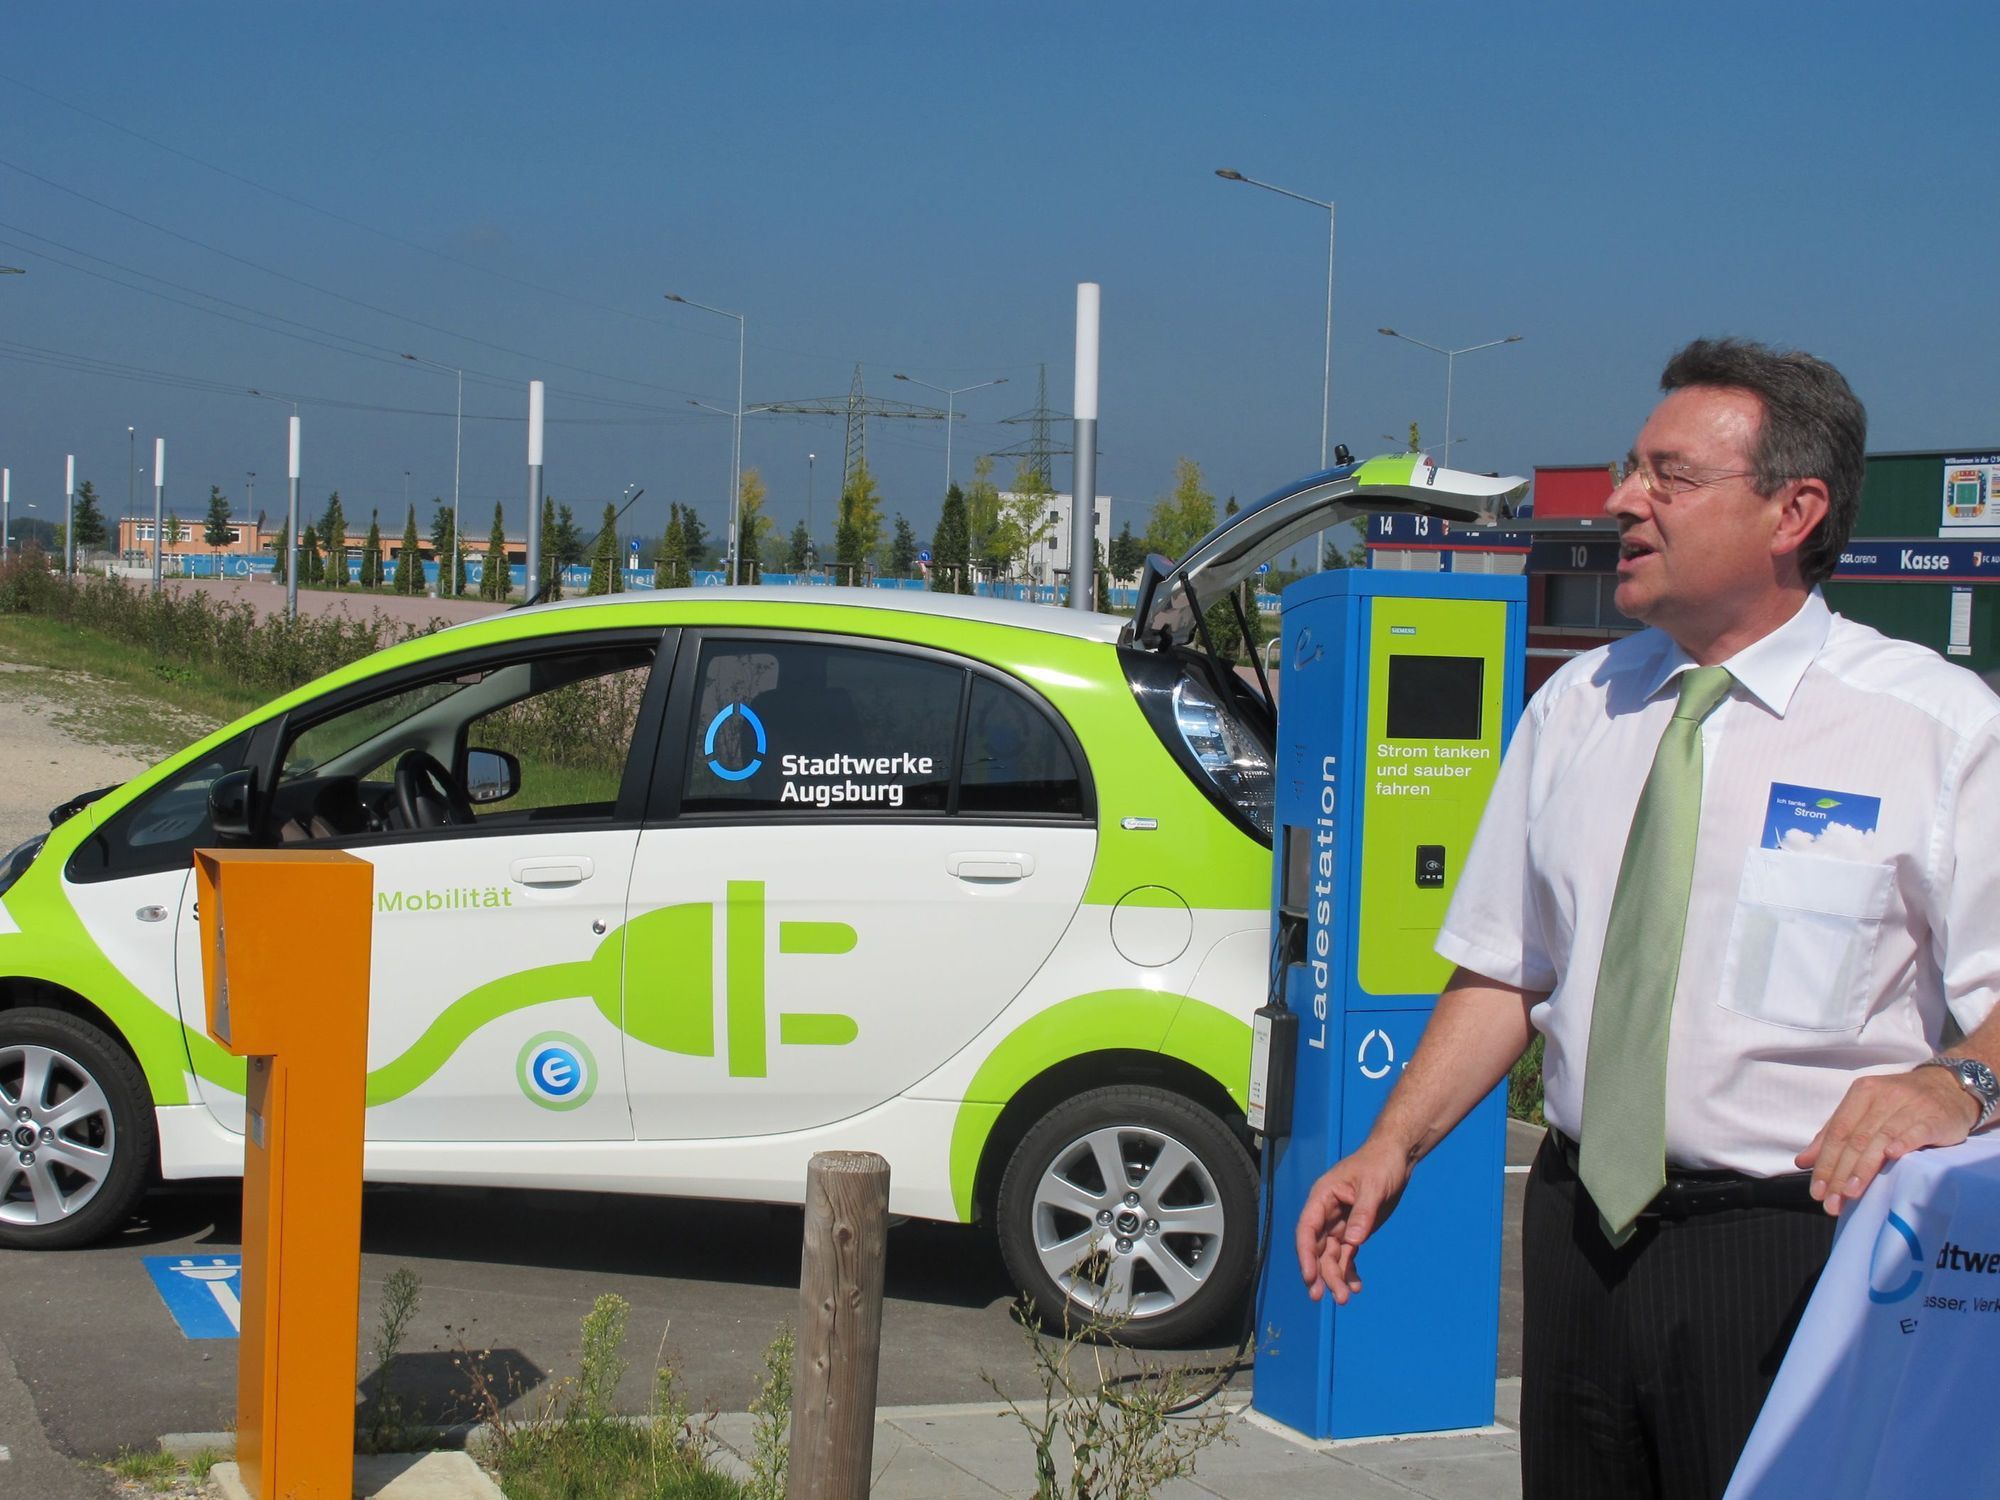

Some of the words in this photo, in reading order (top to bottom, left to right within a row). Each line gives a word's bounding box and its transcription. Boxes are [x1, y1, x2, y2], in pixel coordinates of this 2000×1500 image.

[1379, 516, 1393, 535] 14
[1414, 516, 1429, 536] 13
[1571, 545, 1588, 568] 10
[1901, 549, 1950, 570] Kasse
[1377, 744, 1428, 758] Strom
[1434, 746, 1490, 759] tanken
[782, 752, 934, 776] Stadtwerke
[1376, 764, 1408, 776] und
[1414, 765, 1472, 777] sauber
[780, 780, 904, 808] Augsburg
[1376, 782, 1430, 796] fahren
[1794, 807, 1827, 820] Strom
[1308, 755, 1336, 1050] Ladestation
